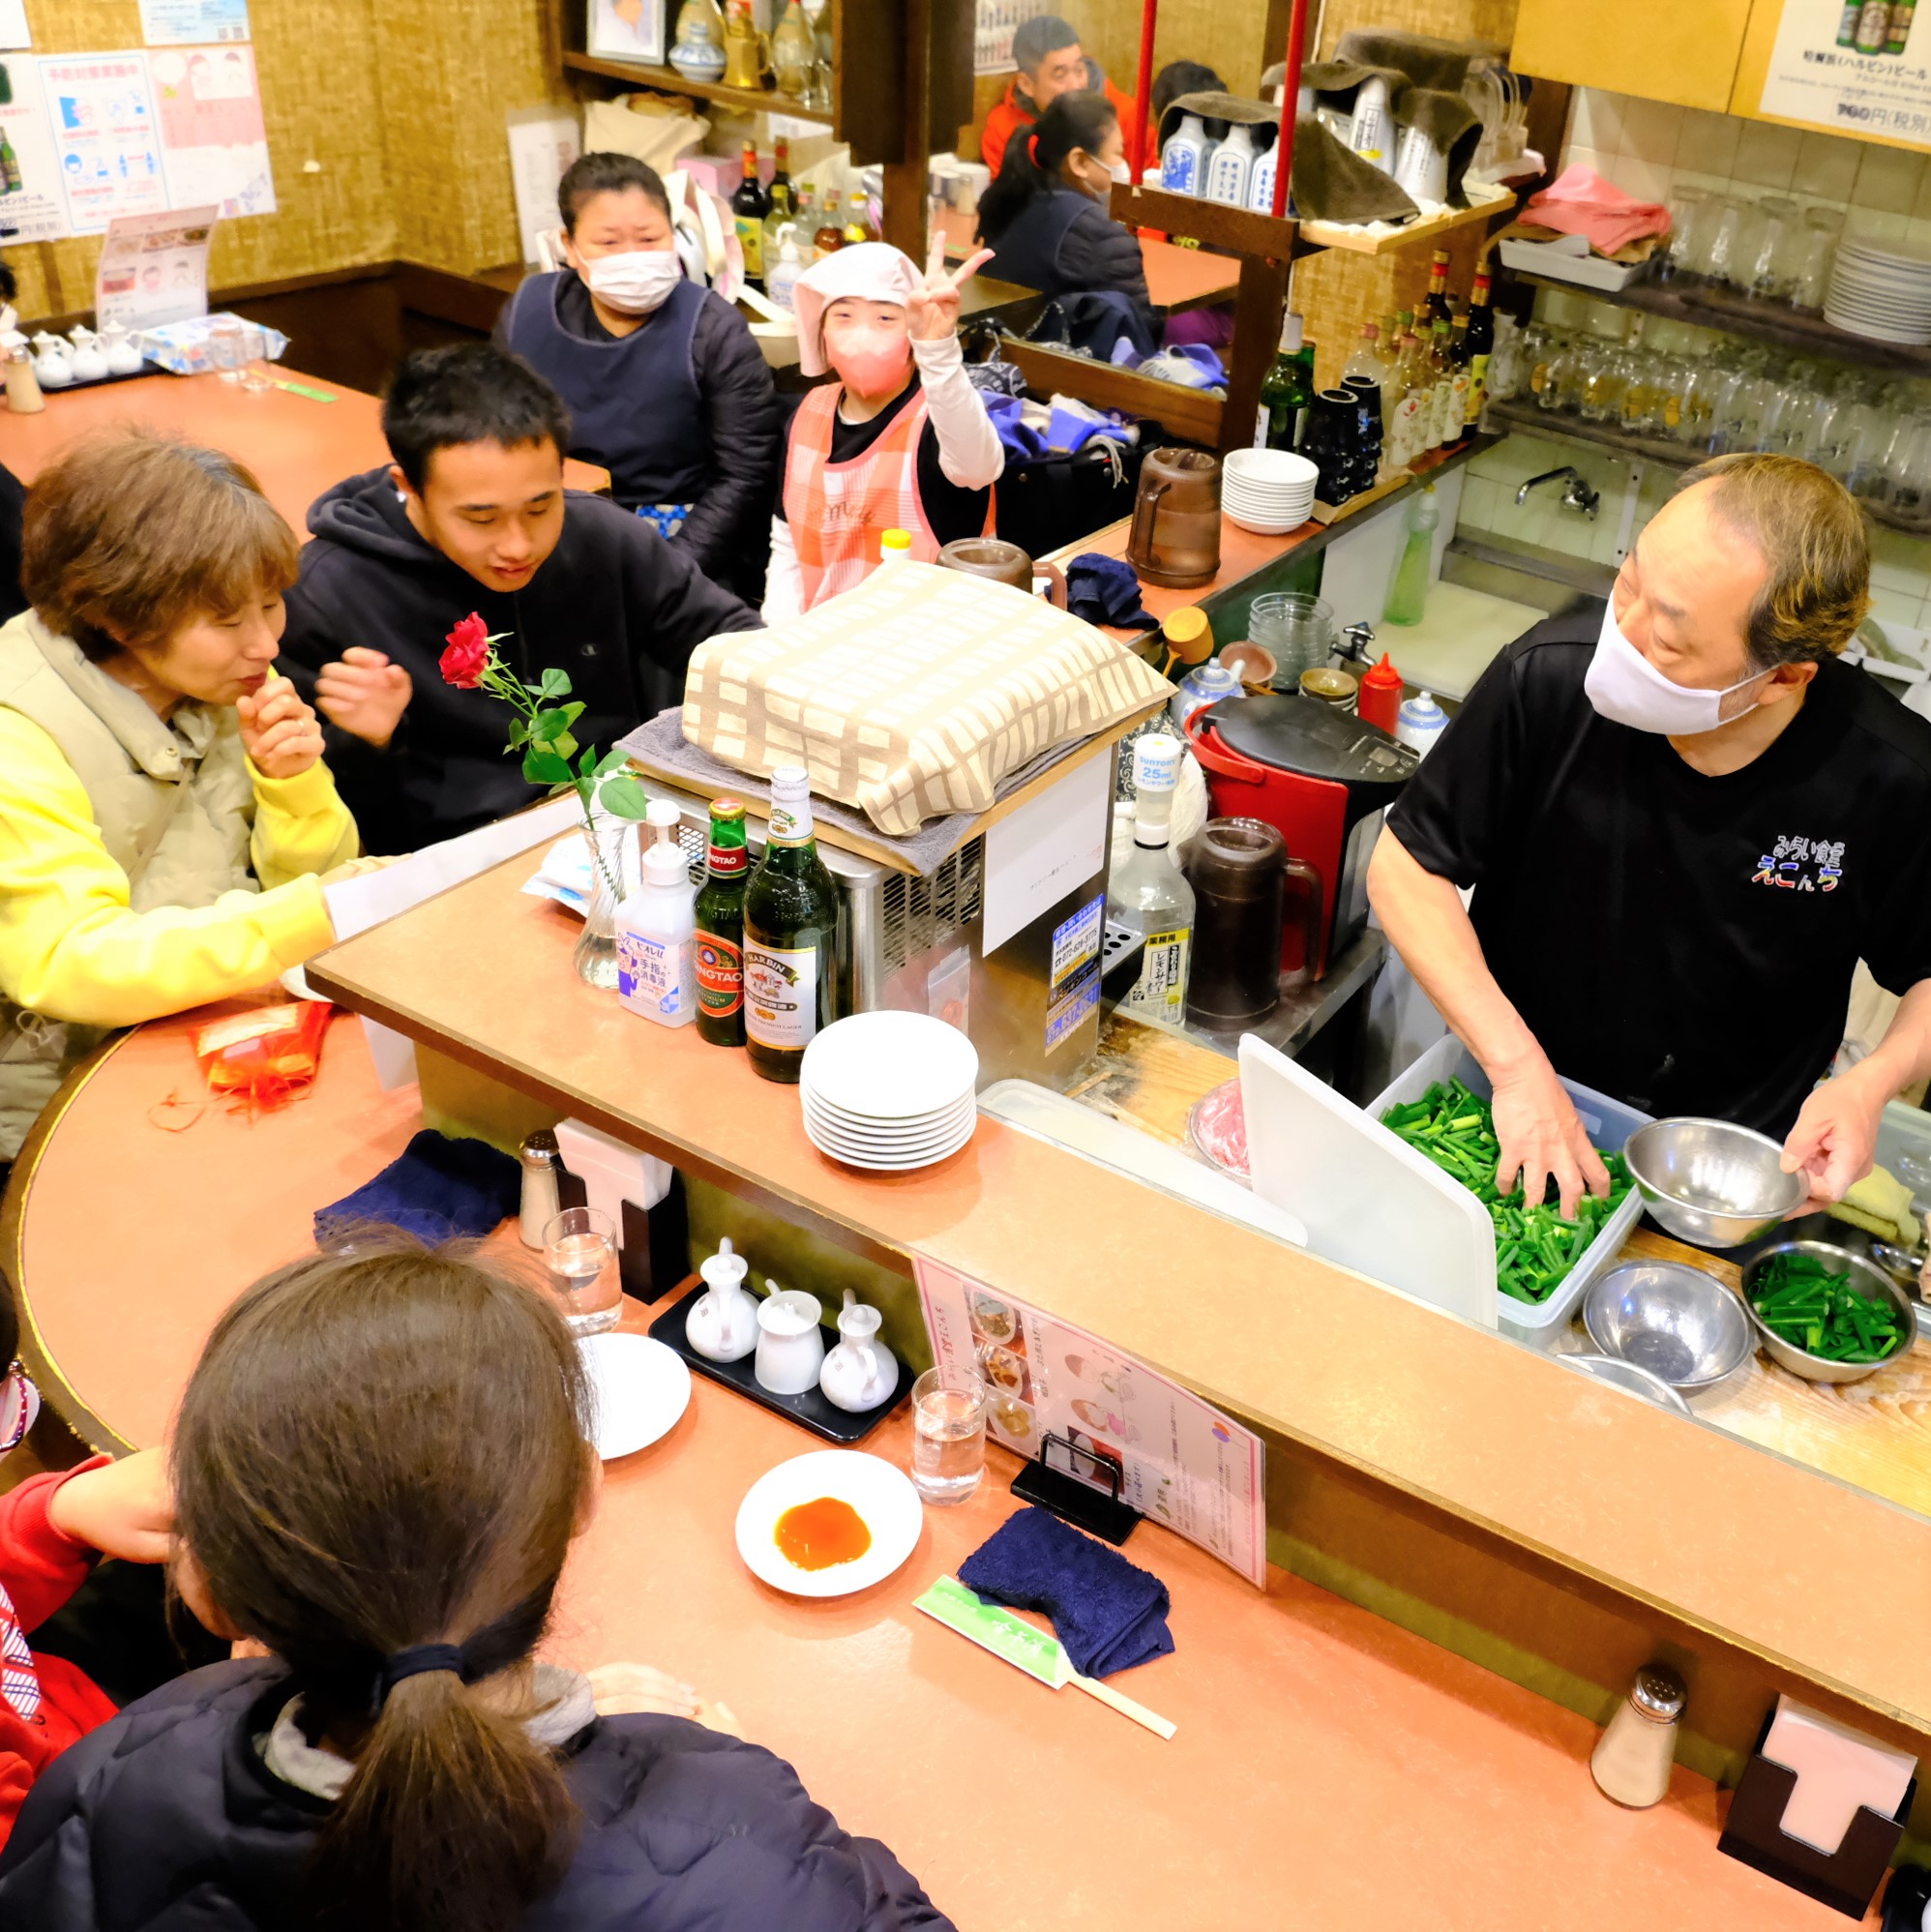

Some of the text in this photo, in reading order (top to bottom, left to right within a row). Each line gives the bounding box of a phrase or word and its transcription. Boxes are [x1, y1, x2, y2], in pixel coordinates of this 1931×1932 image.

[1143, 767, 1172, 780] 25ml
[1773, 835, 1846, 868] みらい食堂
[1751, 854, 1843, 892] えこんち
[1148, 934, 1176, 945] 業務用
[639, 958, 667, 978] 手指の
[748, 952, 787, 974] HARBIN
[1154, 952, 1167, 994] レモンサワー
[640, 968, 668, 989] 消毒液
